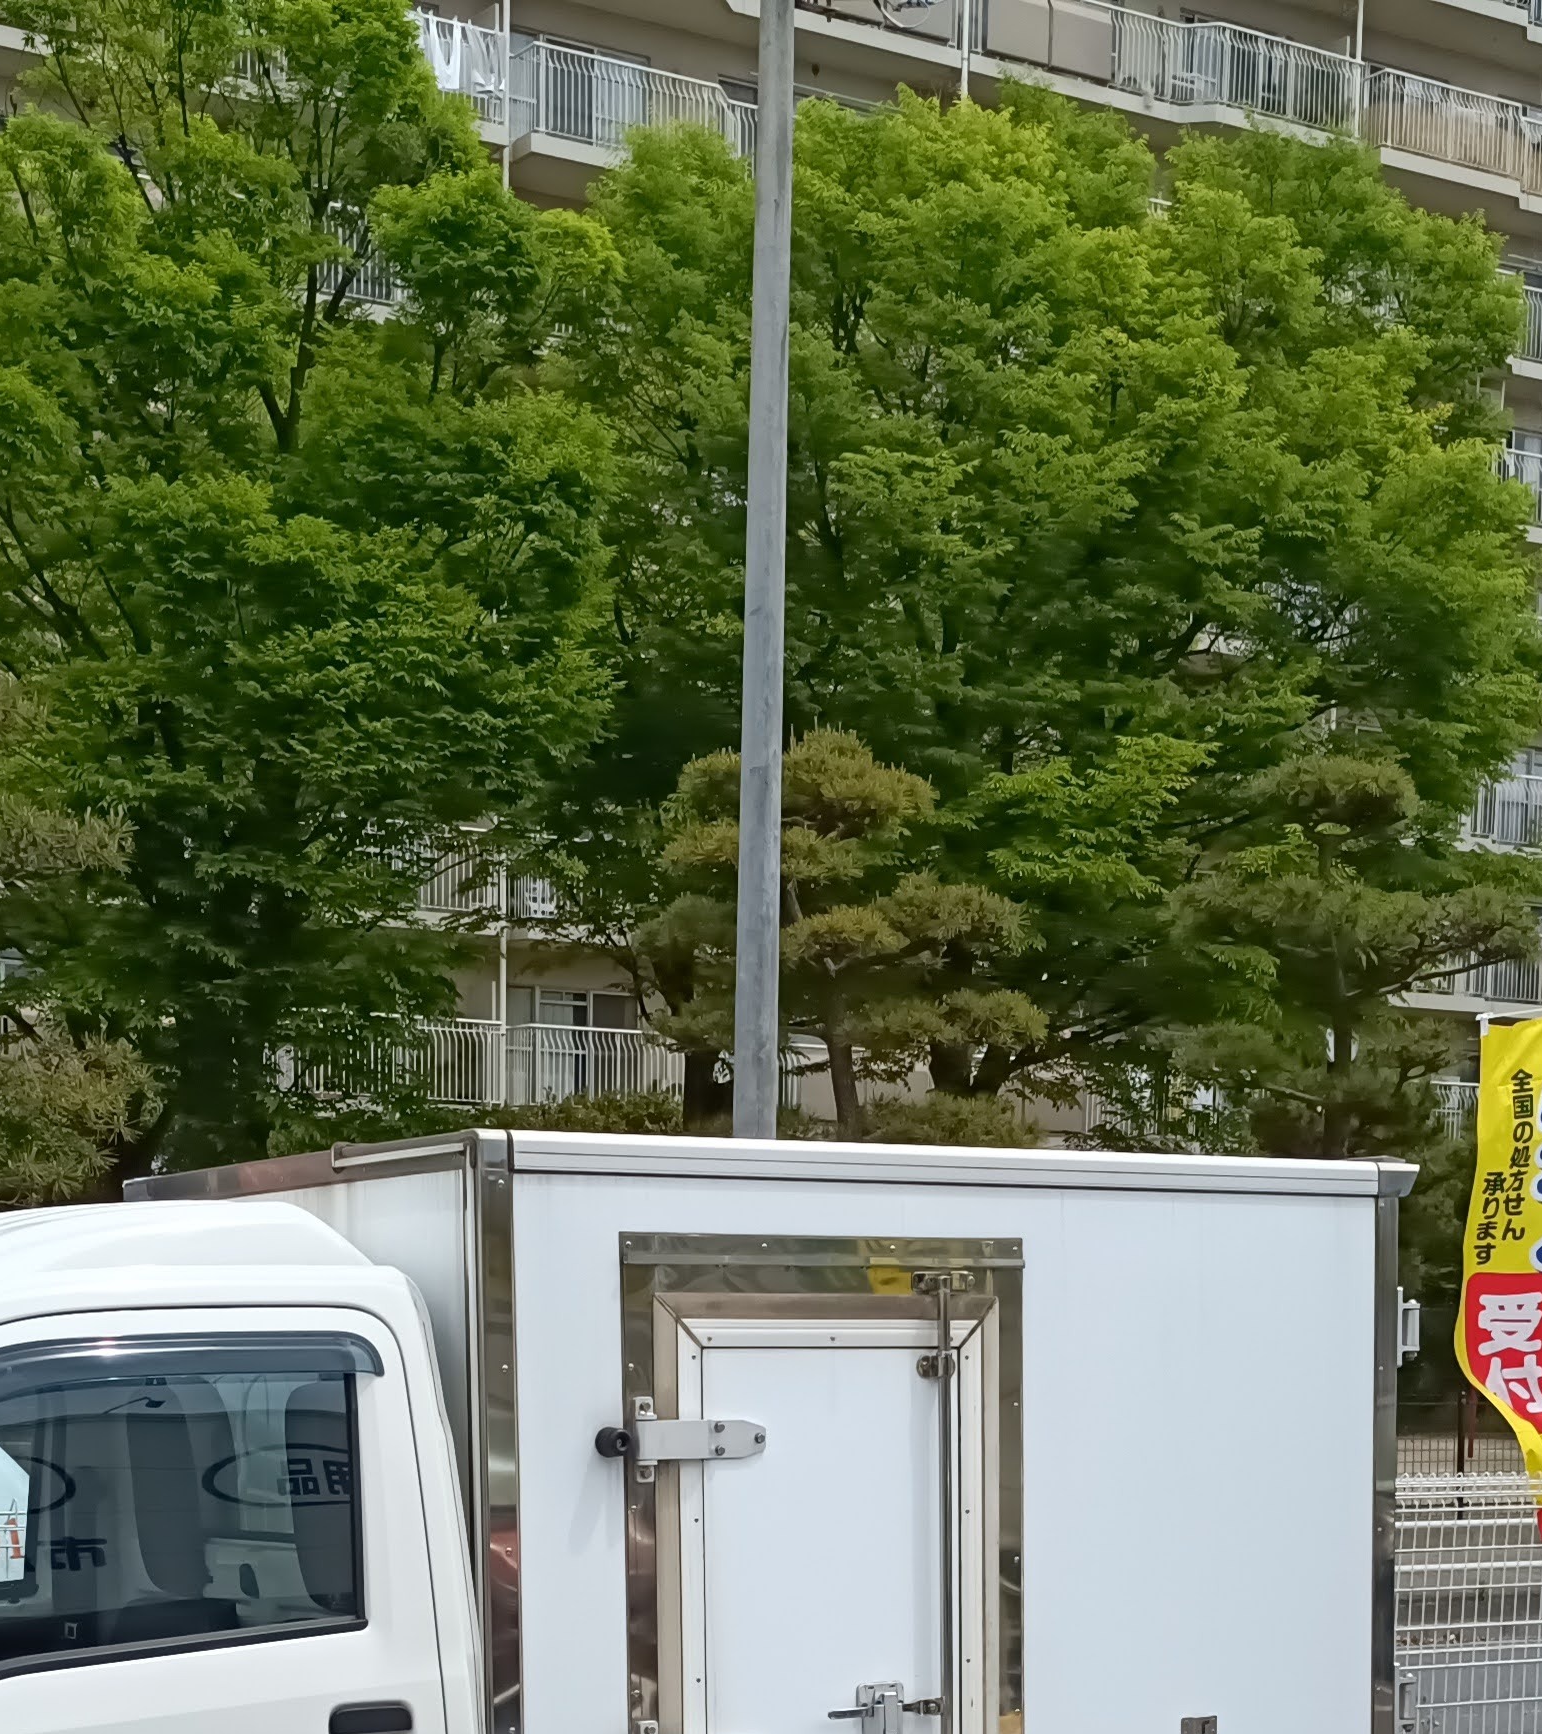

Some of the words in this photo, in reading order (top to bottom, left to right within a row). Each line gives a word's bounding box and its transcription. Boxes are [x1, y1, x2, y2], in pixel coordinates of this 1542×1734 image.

[1473, 1171, 1507, 1265] 承ります
[1502, 1069, 1535, 1241] 全国の処方せん
